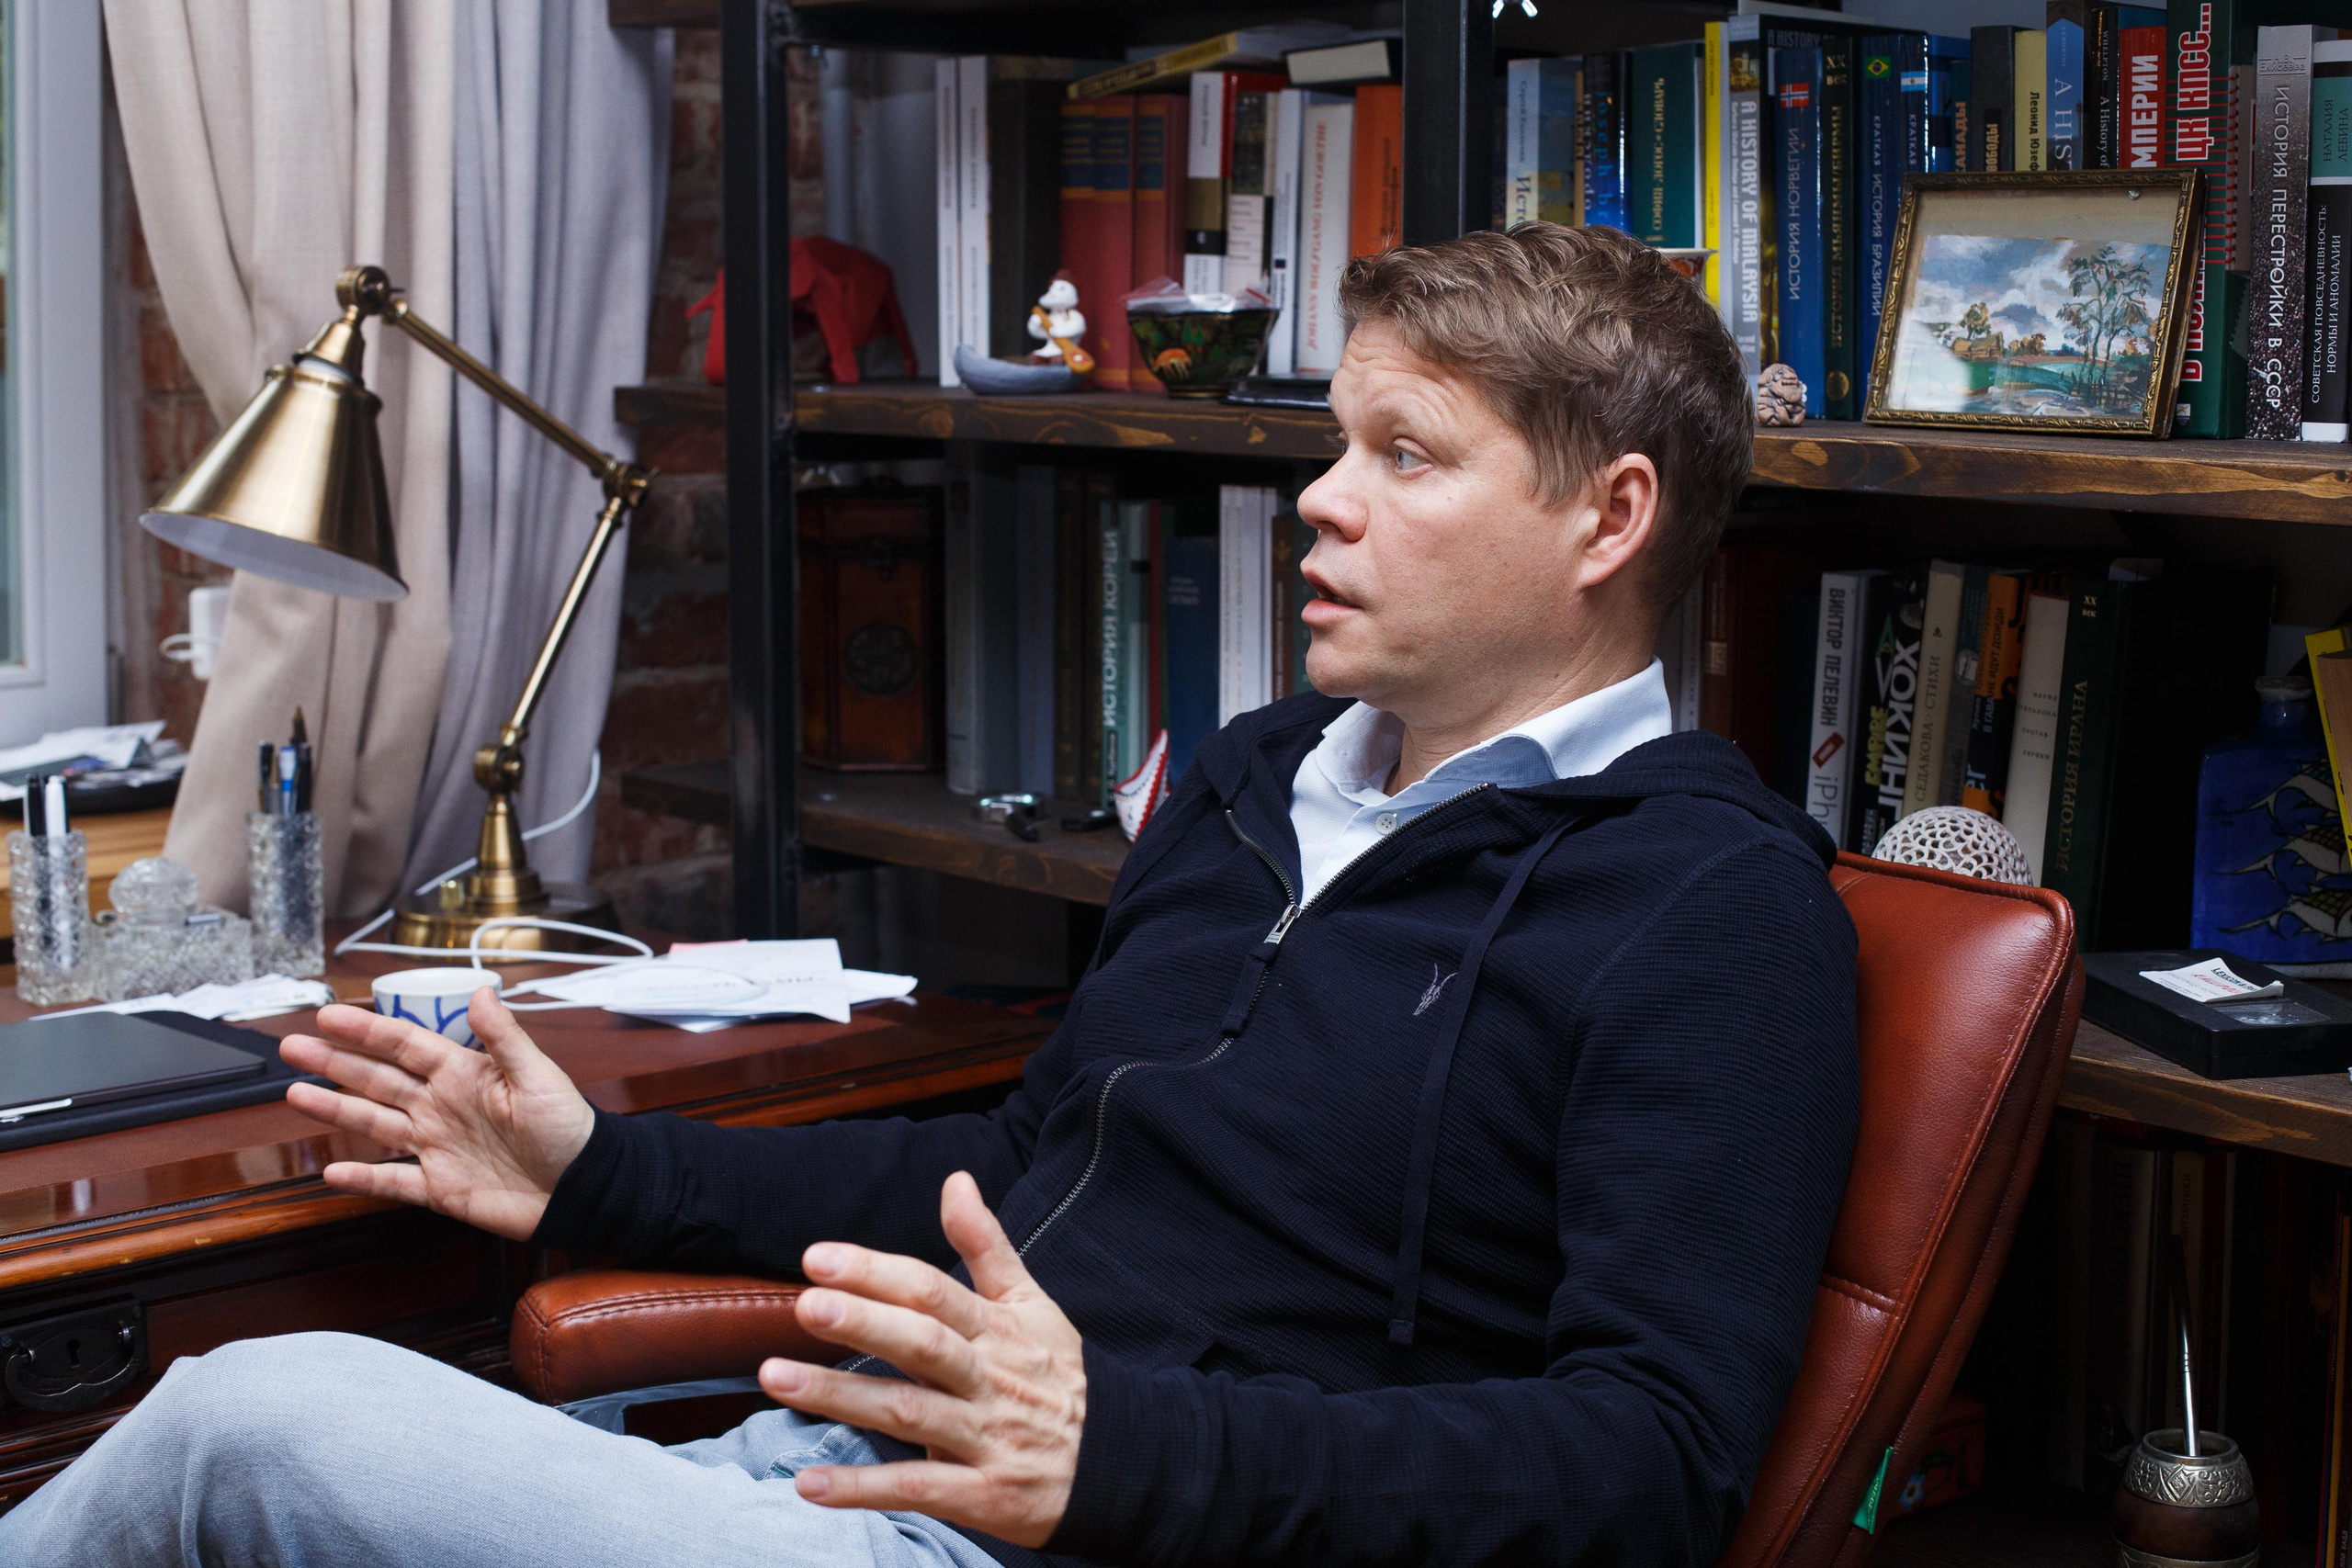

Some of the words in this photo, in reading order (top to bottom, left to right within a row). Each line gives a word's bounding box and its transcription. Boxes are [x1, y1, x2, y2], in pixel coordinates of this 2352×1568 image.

[2054, 78, 2074, 97] A
[2101, 30, 2110, 82] WHELPTON
[1653, 77, 1666, 133] СЛОВАРЬ
[1742, 101, 1758, 113] A
[2029, 92, 2041, 134] Леонид
[2098, 108, 2110, 152] History
[2100, 96, 2110, 106] A
[2131, 54, 2159, 169] МПЕРИИ
[2273, 86, 2291, 177] ИСТОРИЯ
[2323, 99, 2334, 163] НАТАЛИЯ
[1595, 92, 1614, 177] joseph
[1742, 119, 1758, 196] HISTORY
[1872, 115, 1883, 165] КРАТКАЯ
[1907, 113, 1917, 165] КРАТКАЯ
[1985, 123, 2000, 172] ВОБОДЫ
[2030, 138, 2041, 172] Юзеф
[2100, 154, 2110, 169] of
[2176, 117, 2215, 162] ЦК
[2337, 107, 2349, 163] ЛЕБИНА
[1787, 128, 1801, 217] НОРВЕГИИ
[1598, 192, 1614, 220] br
[1742, 200, 1758, 222] OF
[1871, 173, 1883, 239] ИСТОРИЯ
[1742, 227, 1758, 322] MALAYSIA
[1787, 227, 1802, 299] ИСТОРИЯ
[1871, 243, 1883, 316] БРАЗИЛИИ
[2267, 189, 2290, 328] ПЕРЕСТРОЙКИ
[2313, 204, 2328, 327] ПОВСЕДНЕВНОСТЬ:
[2328, 235, 2342, 310] АНОМАЛИИ
[1829, 265, 1843, 348] ИСТОРИЯ
[2329, 313, 2339, 322] И
[2267, 338, 2282, 348] В
[2311, 329, 2323, 404] СОВЕТСКАЯ
[2326, 324, 2339, 374] НОРМЫ
[2265, 357, 2283, 409] СССР
[1102, 531, 1120, 610] КОРЕИ
[1827, 587, 1847, 649] ВИКТОР
[1102, 615, 1119, 728] ИСТОРИЯ
[1819, 654, 1842, 728] ПЕЛЕВИН
[1924, 655, 1941, 710] СТИХИ
[1863, 704, 1890, 787] EMPIRE
[1877, 638, 1921, 821] ХОКИНГ
[2067, 680, 2089, 759] ИРАНА
[1916, 721, 1934, 802] СЕДАКОВА
[2056, 759, 2080, 871] ИСТОРИЯ
